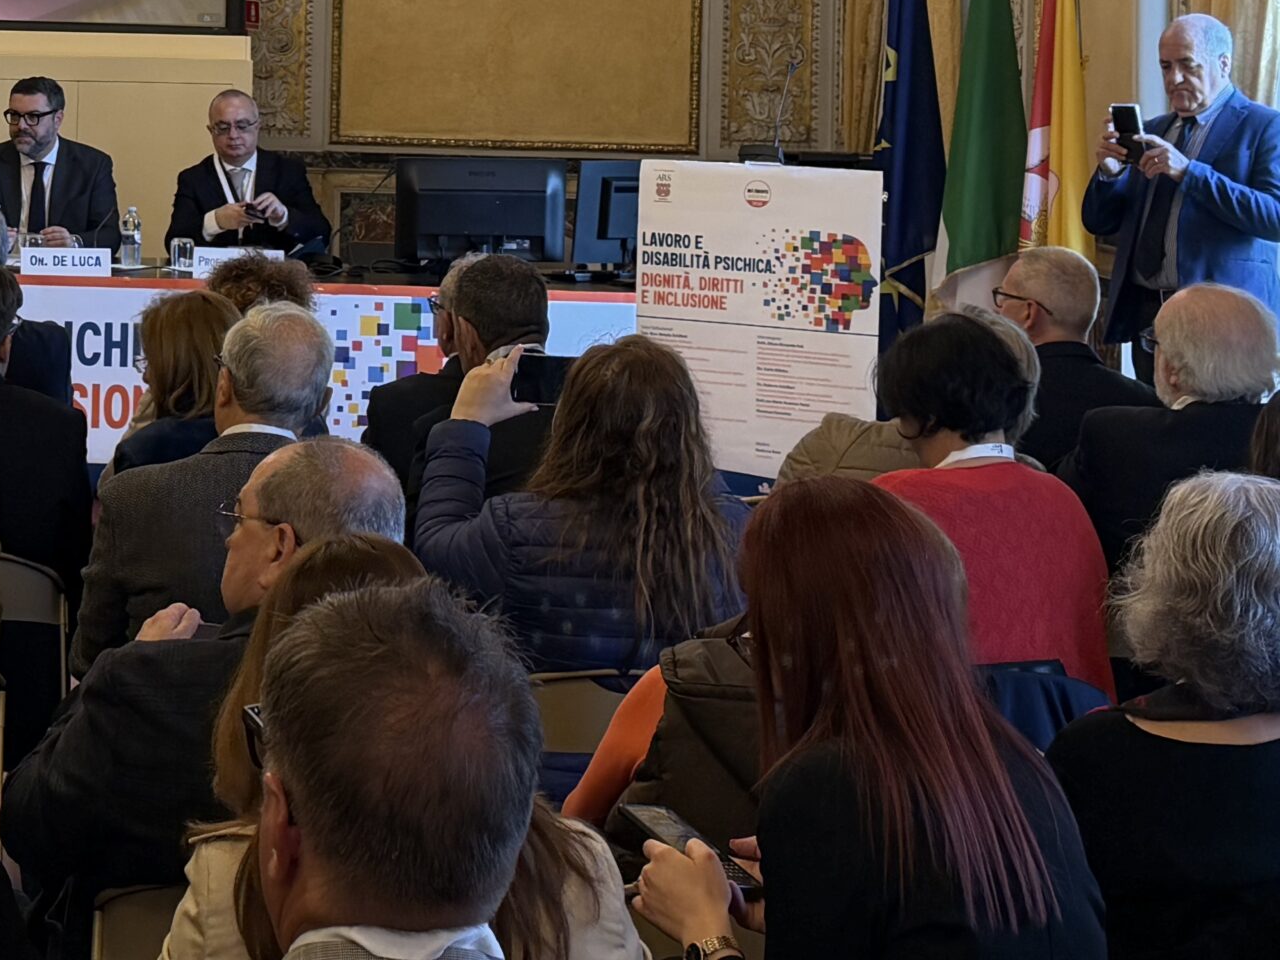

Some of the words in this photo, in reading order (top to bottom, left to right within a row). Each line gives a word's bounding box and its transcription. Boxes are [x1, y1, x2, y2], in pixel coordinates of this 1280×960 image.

[642, 231, 691, 249] LAVORO
[695, 235, 703, 250] E
[53, 255, 68, 267] DE
[72, 255, 102, 268] LUCA
[642, 250, 710, 269] DISABILITÀ
[714, 256, 776, 274] PSICHICA:
[641, 271, 694, 291] DIGNITÀ,
[699, 277, 744, 294] DIRITTI
[641, 292, 649, 304] E
[653, 292, 727, 310] INCLUSIONE
